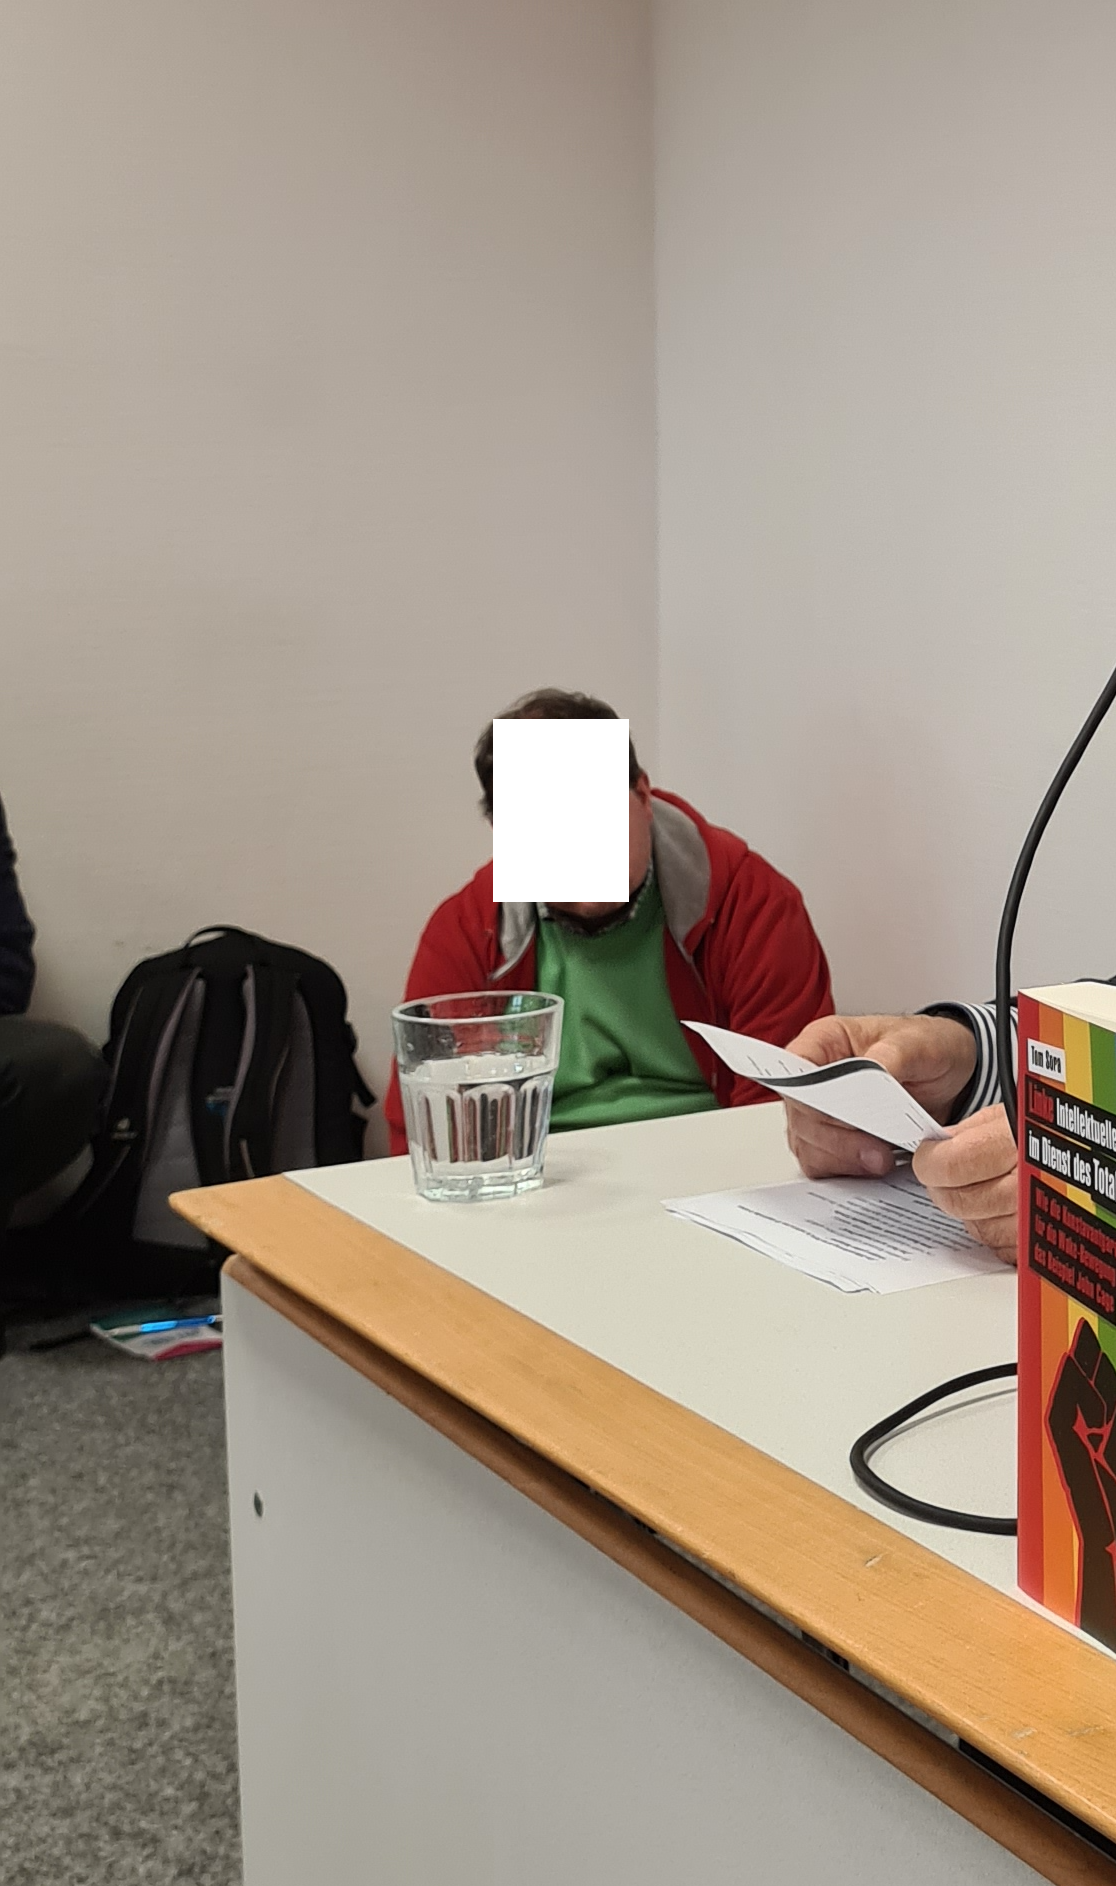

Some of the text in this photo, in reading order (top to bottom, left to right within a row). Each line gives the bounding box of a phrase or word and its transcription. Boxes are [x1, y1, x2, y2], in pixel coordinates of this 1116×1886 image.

[1031, 1045, 1062, 1074] Tom Sora
[1028, 1081, 1055, 1123] Linke
[1028, 1130, 1040, 1161] im
[1041, 1136, 1071, 1178] Dienst
[1073, 1152, 1092, 1187] des
[1050, 1198, 1061, 1220] die
[1034, 1243, 1046, 1266] das
[1076, 1272, 1095, 1299] John
[1096, 1283, 1115, 1313] Cage
